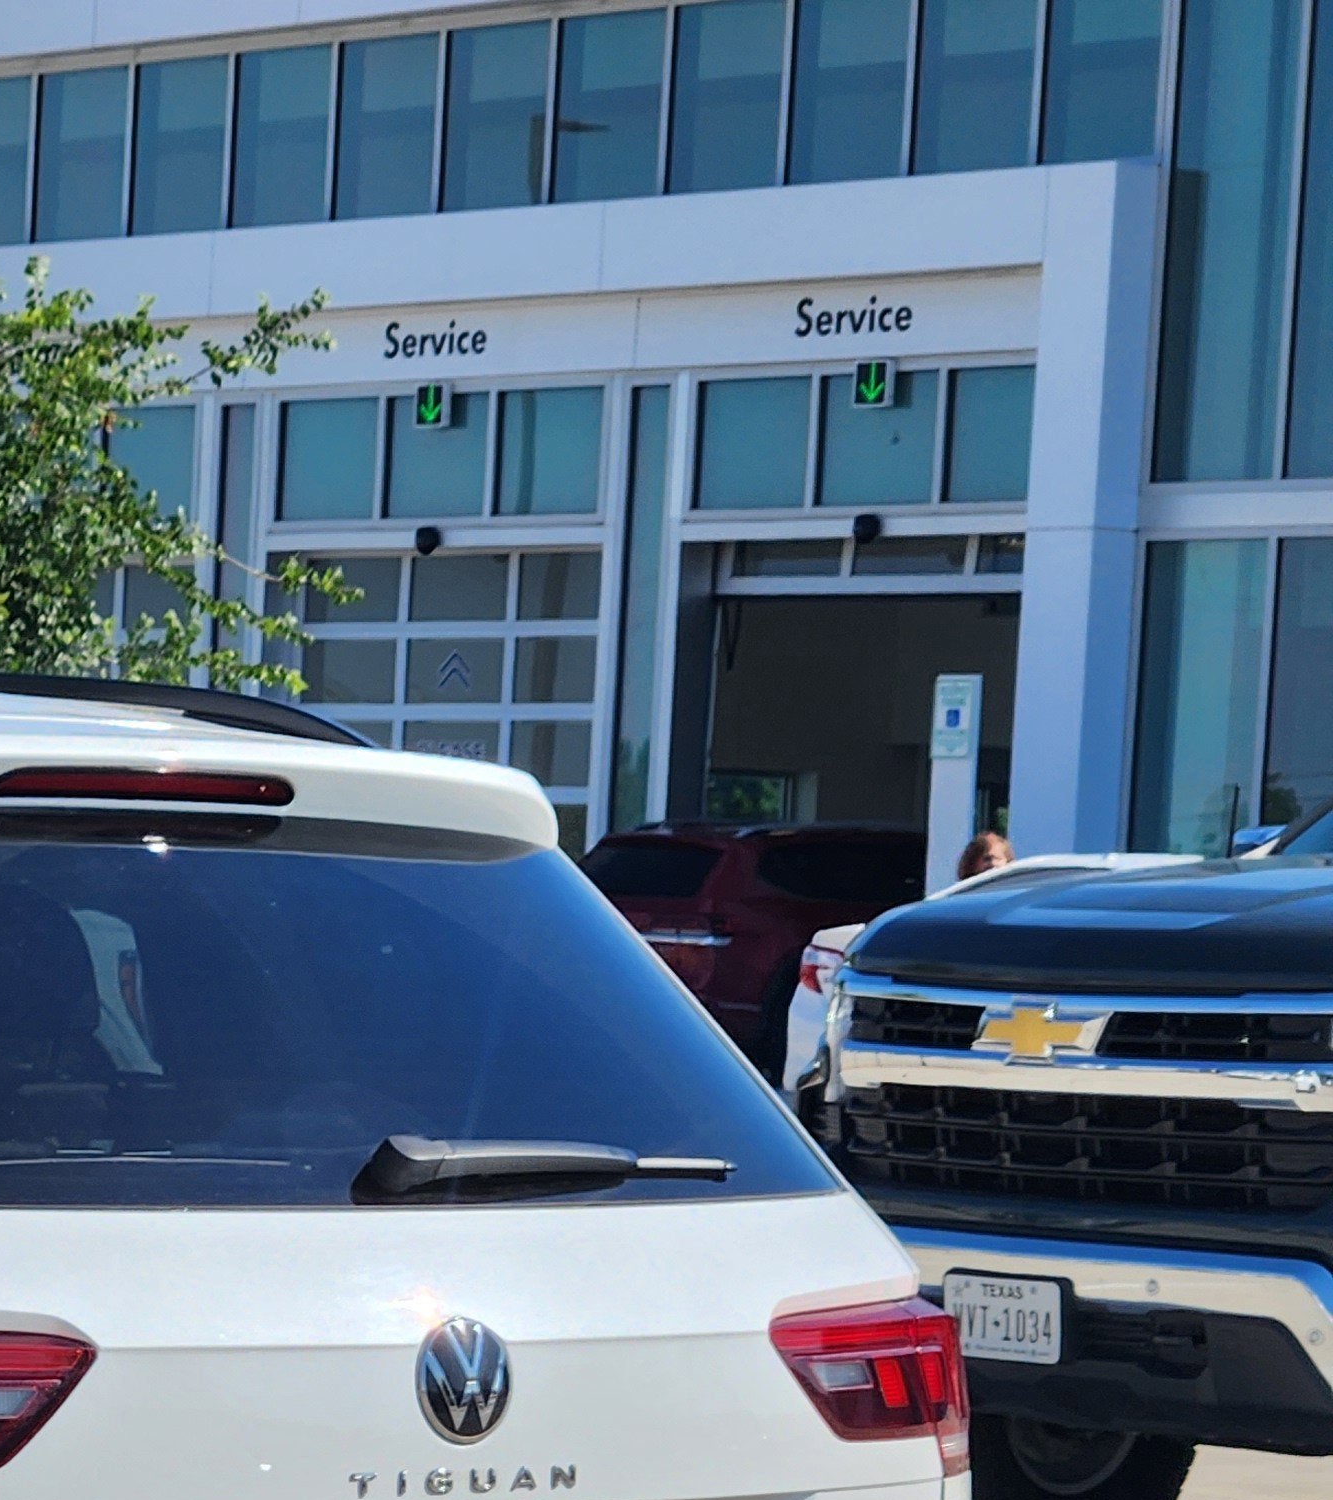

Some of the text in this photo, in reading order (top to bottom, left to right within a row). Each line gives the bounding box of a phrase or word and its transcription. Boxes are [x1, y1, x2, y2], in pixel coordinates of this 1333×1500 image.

[795, 295, 914, 338] Service
[384, 319, 488, 360] Service
[981, 1283, 1024, 1300] TEXAS
[349, 1464, 579, 1500] TIGUAN
